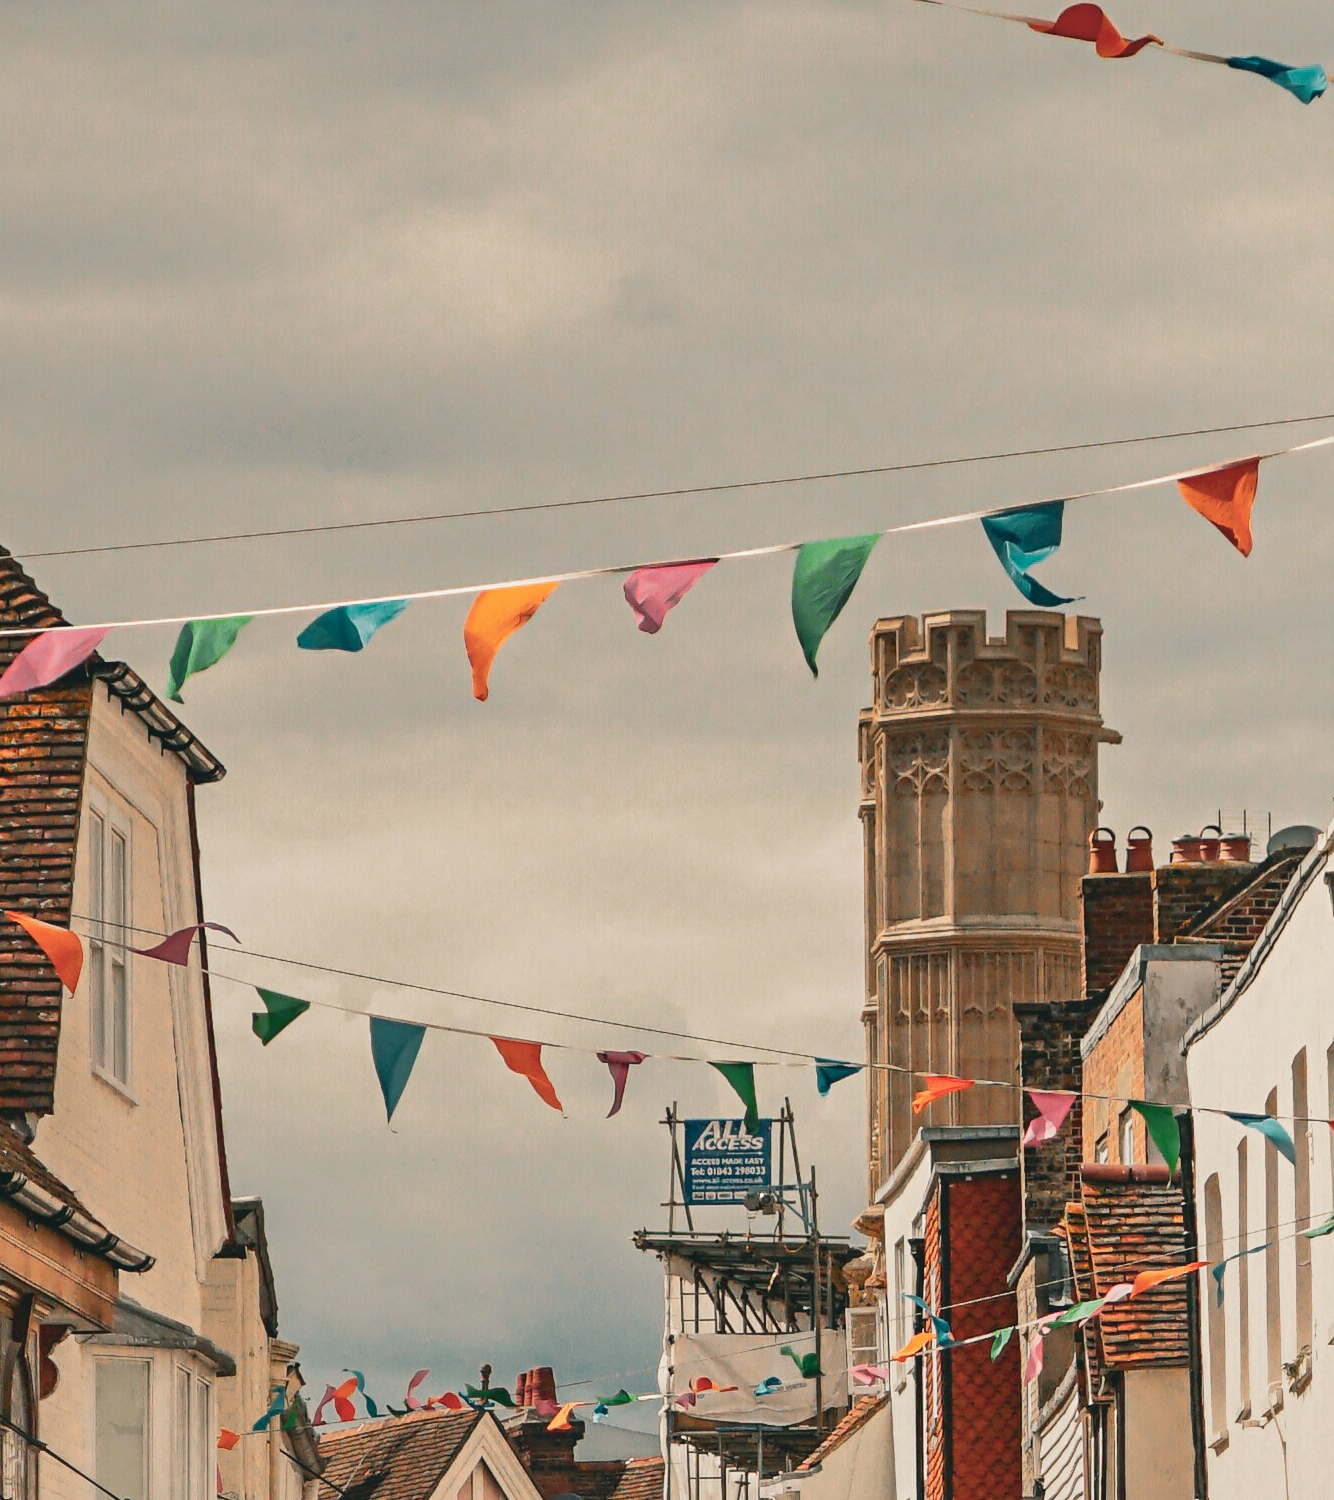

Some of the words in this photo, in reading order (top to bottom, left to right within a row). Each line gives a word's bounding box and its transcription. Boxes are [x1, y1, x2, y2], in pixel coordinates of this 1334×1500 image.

[700, 1120, 754, 1140] ALL
[691, 1136, 764, 1151] ACCESS
[745, 1157, 764, 1165] EASY
[707, 1167, 733, 1176] 01843
